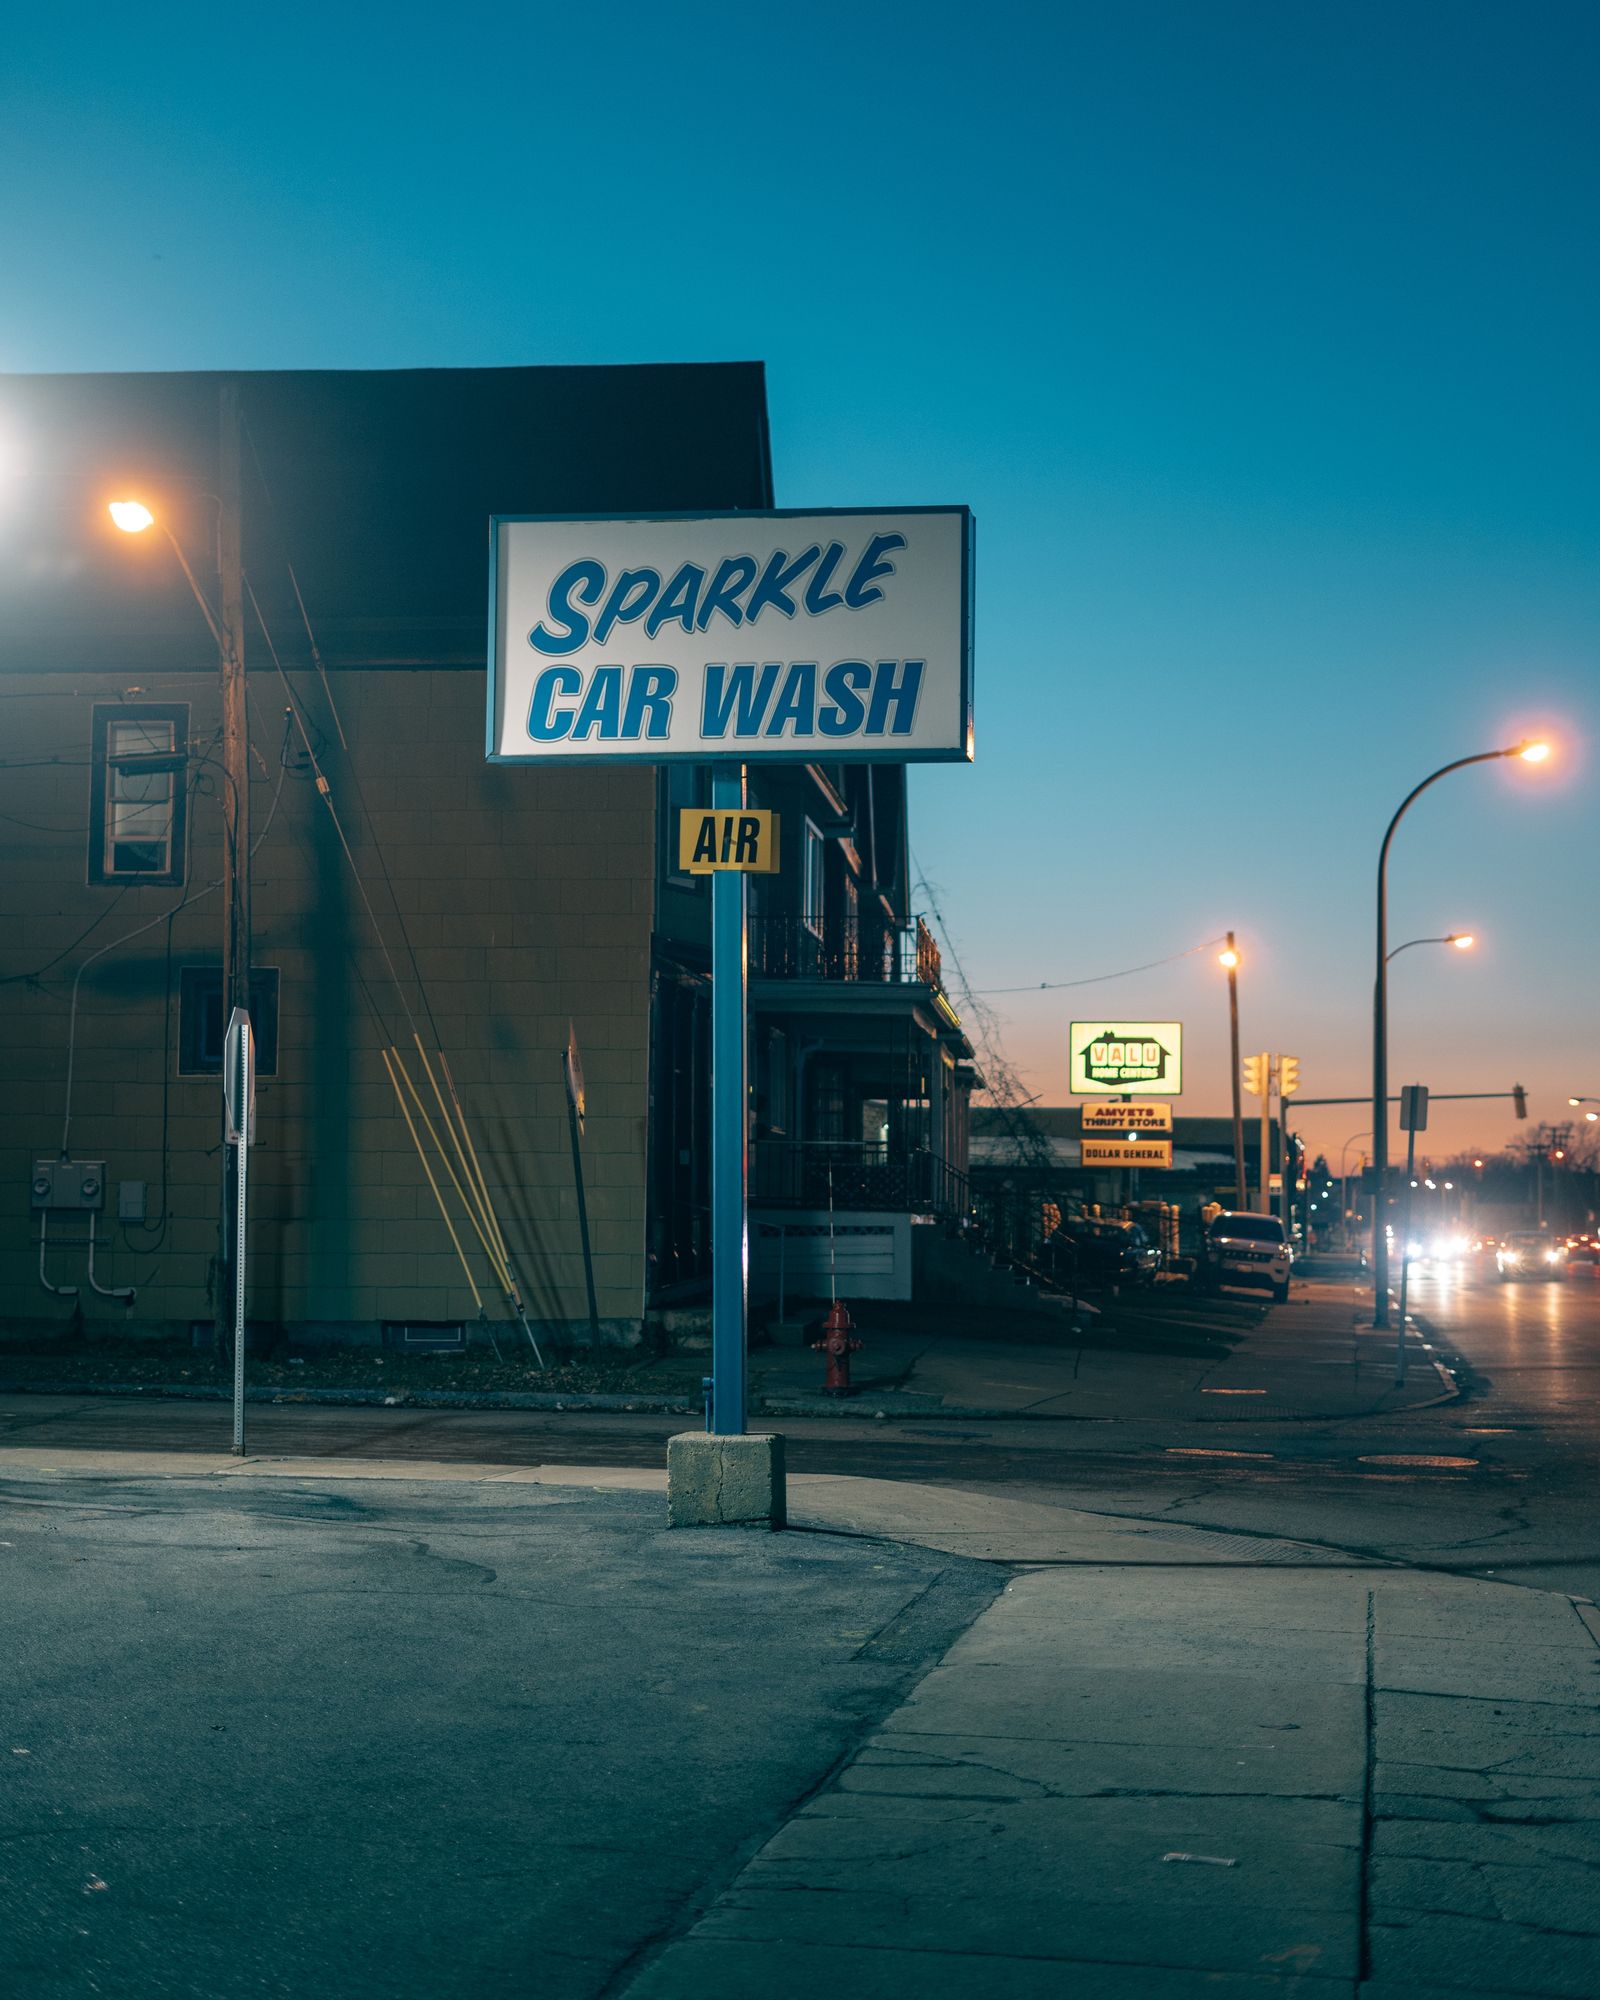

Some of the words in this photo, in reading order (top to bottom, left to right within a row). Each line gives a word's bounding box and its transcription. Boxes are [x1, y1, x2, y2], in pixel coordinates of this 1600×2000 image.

[528, 532, 907, 656] SPARKLE
[526, 664, 679, 742] CAR
[700, 660, 926, 738] WASH
[692, 816, 760, 863] AIR
[1094, 1047, 1156, 1062] VALU
[1095, 1108, 1155, 1117] AMVETS
[1084, 1118, 1124, 1127] THRIFT
[1128, 1118, 1166, 1127] STORE
[1085, 1149, 1120, 1158] DOLLAR
[1123, 1149, 1165, 1159] GENERAL
